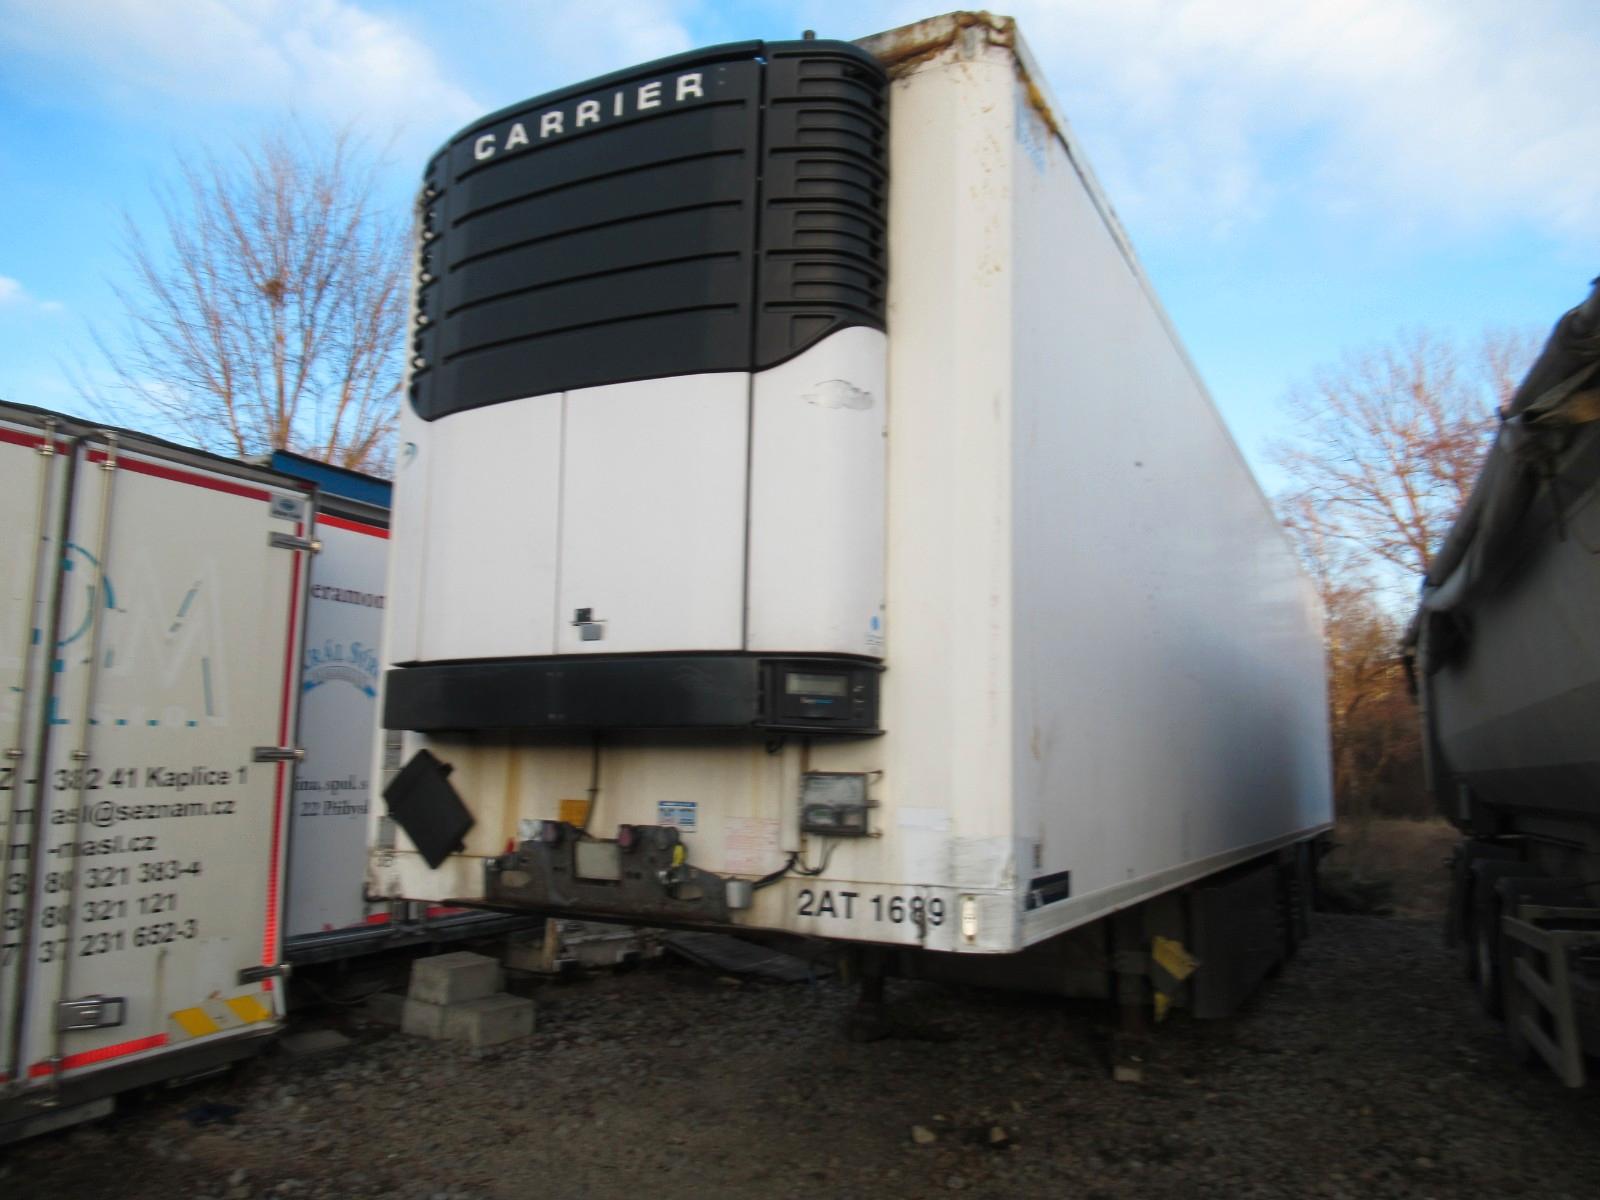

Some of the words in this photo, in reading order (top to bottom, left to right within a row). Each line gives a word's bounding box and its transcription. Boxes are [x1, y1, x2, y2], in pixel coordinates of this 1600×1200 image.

[474, 72, 704, 161] CARRIER
[53, 767, 103, 791] 382
[108, 767, 138, 789] 41
[145, 765, 232, 791] Kaplice
[236, 765, 248, 785] 1
[85, 866, 129, 889] 321
[137, 859, 202, 884] 383-4
[82, 899, 128, 923] 321
[137, 892, 177, 914] 121
[797, 889, 859, 919] 2AT
[79, 929, 125, 957] 231
[132, 918, 199, 948] 652-3
